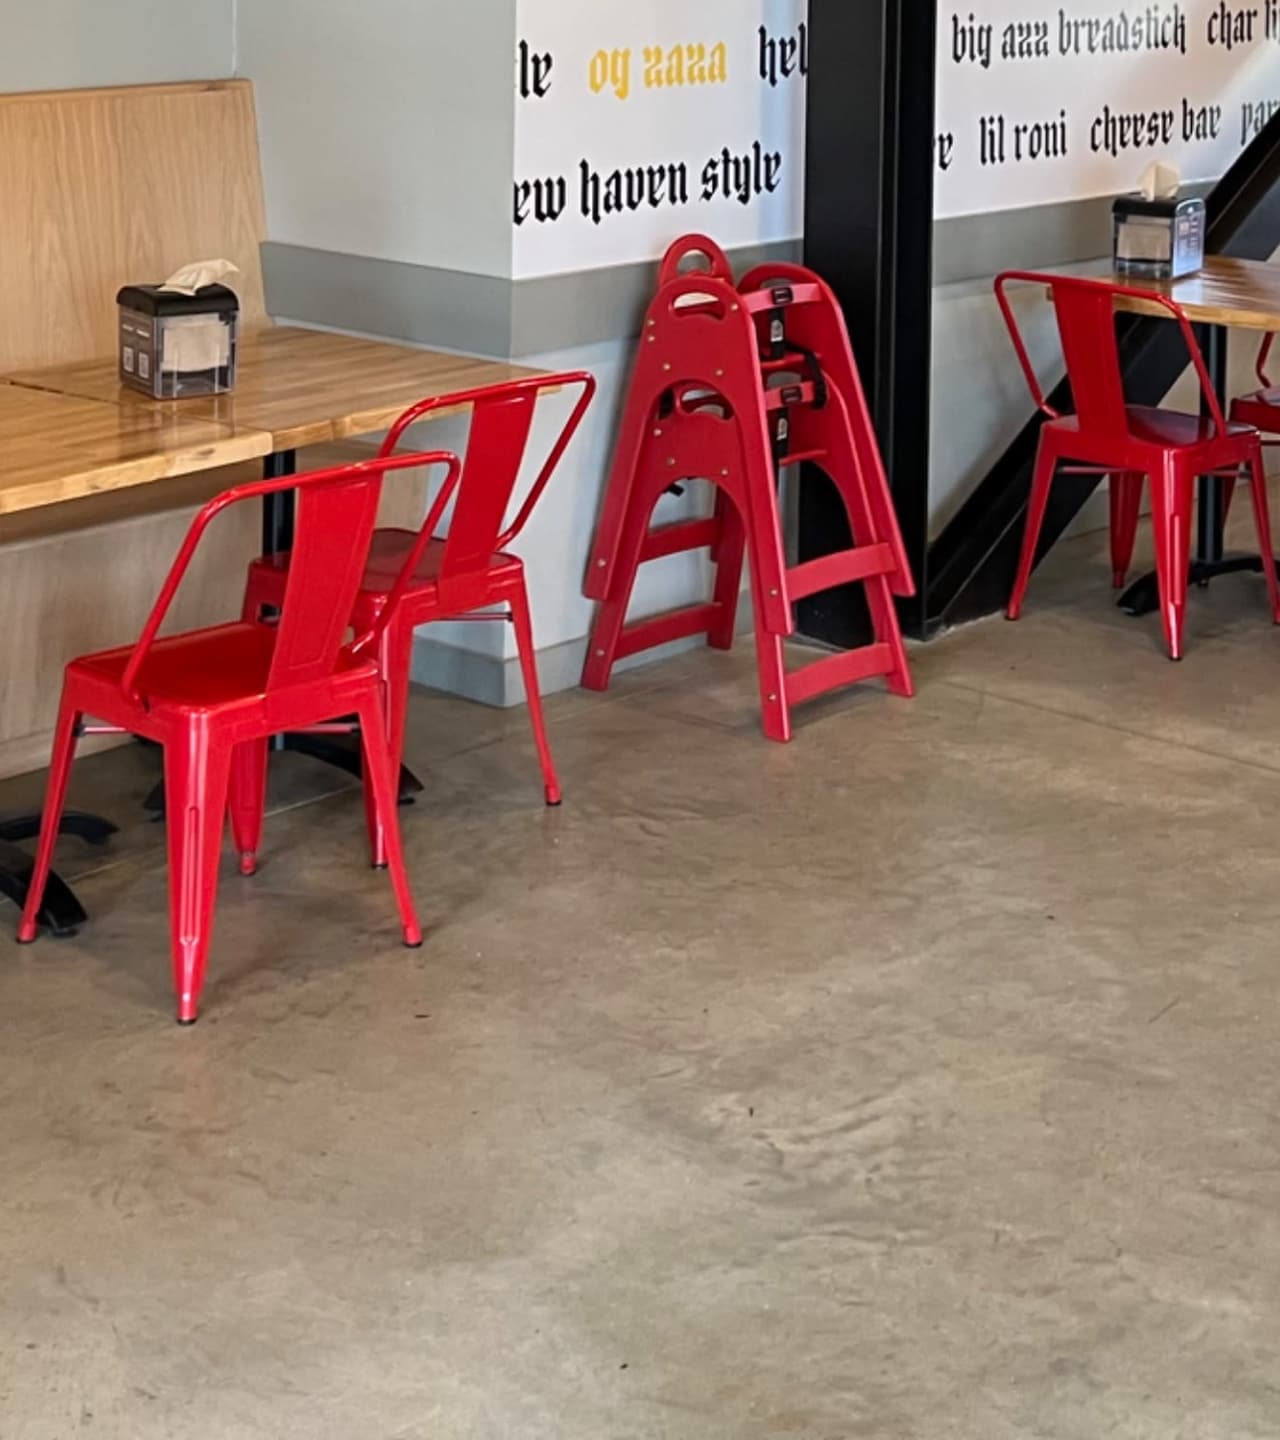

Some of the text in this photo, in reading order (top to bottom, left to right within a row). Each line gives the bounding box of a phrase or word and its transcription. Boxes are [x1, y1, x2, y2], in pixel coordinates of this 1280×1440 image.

[952, 13, 993, 69] big
[1001, 19, 1049, 60] azz
[1058, 3, 1187, 56] breadstick
[1207, 0, 1258, 54] char
[588, 41, 728, 101] og zaza
[979, 97, 1222, 167] lil roni cheese bae
[579, 140, 782, 225] haven style
